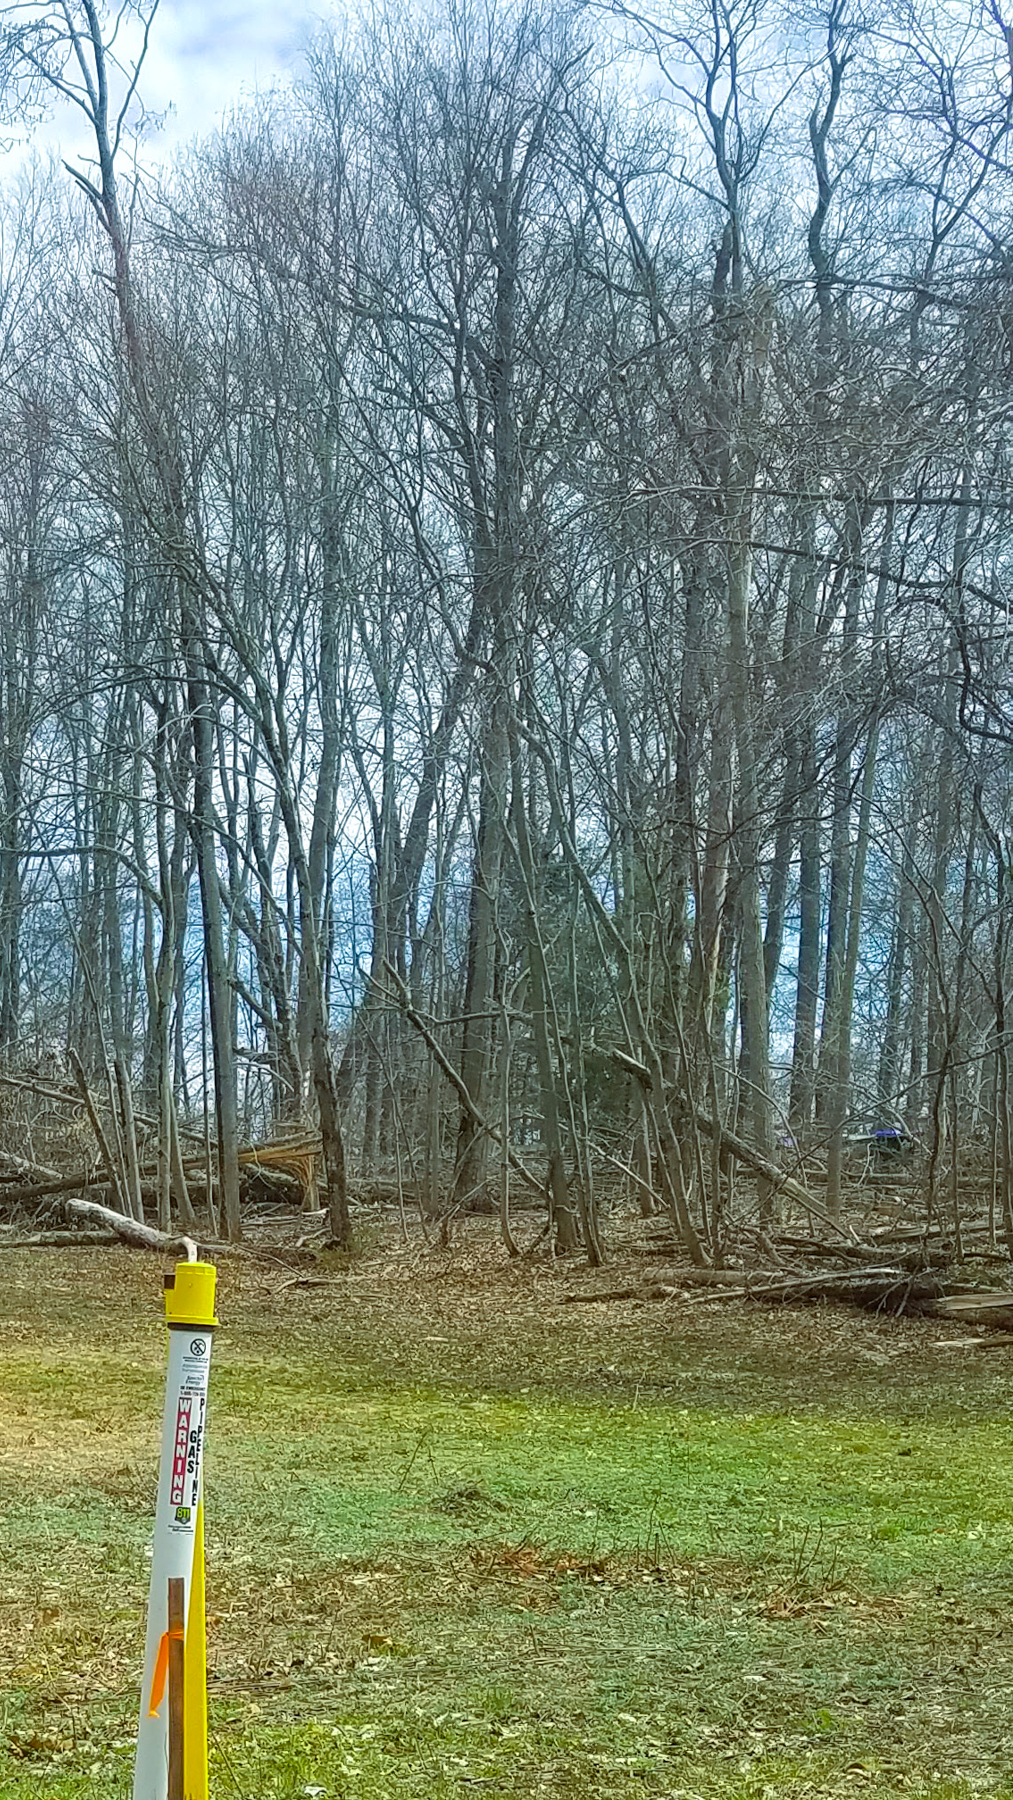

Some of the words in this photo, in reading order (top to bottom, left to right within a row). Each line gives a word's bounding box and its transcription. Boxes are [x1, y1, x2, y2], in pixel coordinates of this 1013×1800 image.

[172, 1398, 191, 1504] WARNING
[186, 1430, 197, 1473] GAS
[191, 1398, 205, 1506] PIPELINE
[177, 1508, 190, 1518] 811
